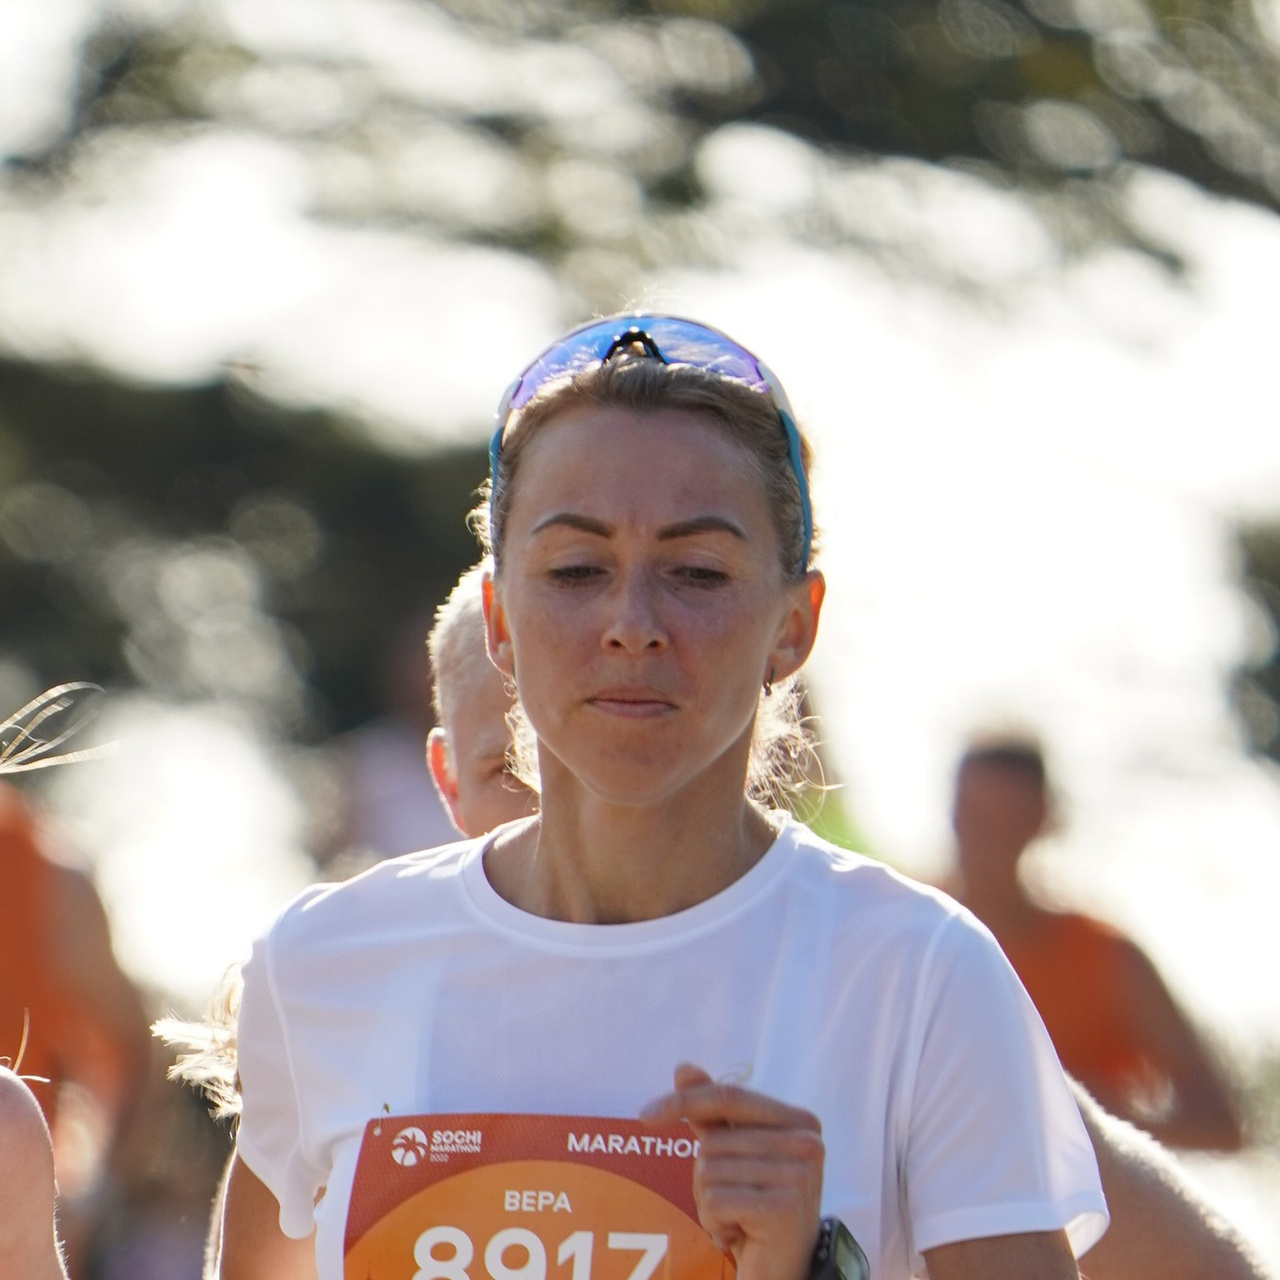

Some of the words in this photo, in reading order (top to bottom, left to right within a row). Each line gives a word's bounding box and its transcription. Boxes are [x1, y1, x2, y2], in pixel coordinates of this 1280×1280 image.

[431, 1130, 482, 1144] SOCHI
[429, 1143, 480, 1153] MARATHON
[504, 1190, 572, 1213] ВЕРА
